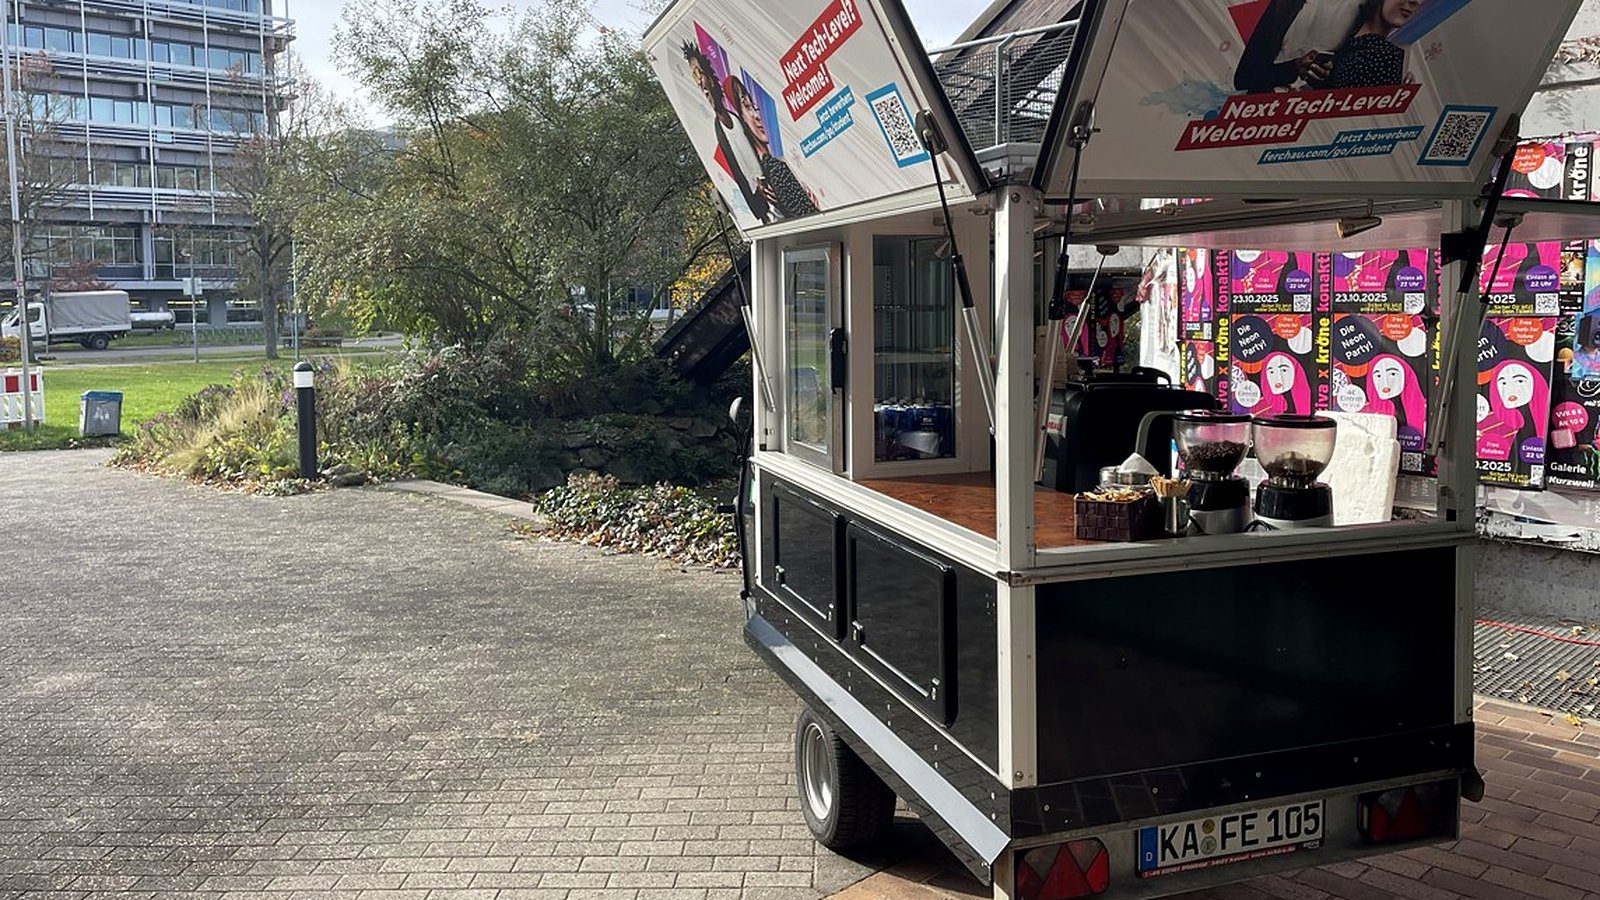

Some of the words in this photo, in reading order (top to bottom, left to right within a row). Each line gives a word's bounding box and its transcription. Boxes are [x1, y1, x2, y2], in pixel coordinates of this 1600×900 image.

[784, 52, 808, 84] Next
[801, 0, 857, 65] Tech-Level?
[786, 63, 830, 112] Welcome!
[1223, 96, 1279, 121] Next
[1284, 90, 1412, 116] Tech-Level?
[1188, 119, 1303, 144] Welcome!
[1262, 143, 1393, 163] ferchau.com/go/student
[1232, 294, 1280, 304] 23.10.2025
[1335, 292, 1389, 303] 23.10.2025
[1237, 324, 1252, 336] Die
[1339, 324, 1356, 337] Die
[1239, 331, 1261, 348] Neon
[1341, 332, 1366, 349] Neon
[1242, 339, 1267, 358] Party!
[1345, 341, 1374, 360] Party!
[1550, 461, 1588, 475] Galerie
[1548, 475, 1595, 488] Kurzweil
[1160, 822, 1199, 862] KA
[1220, 812, 1259, 851] FE
[1266, 802, 1321, 843] 105
[1145, 851, 1154, 862] D
